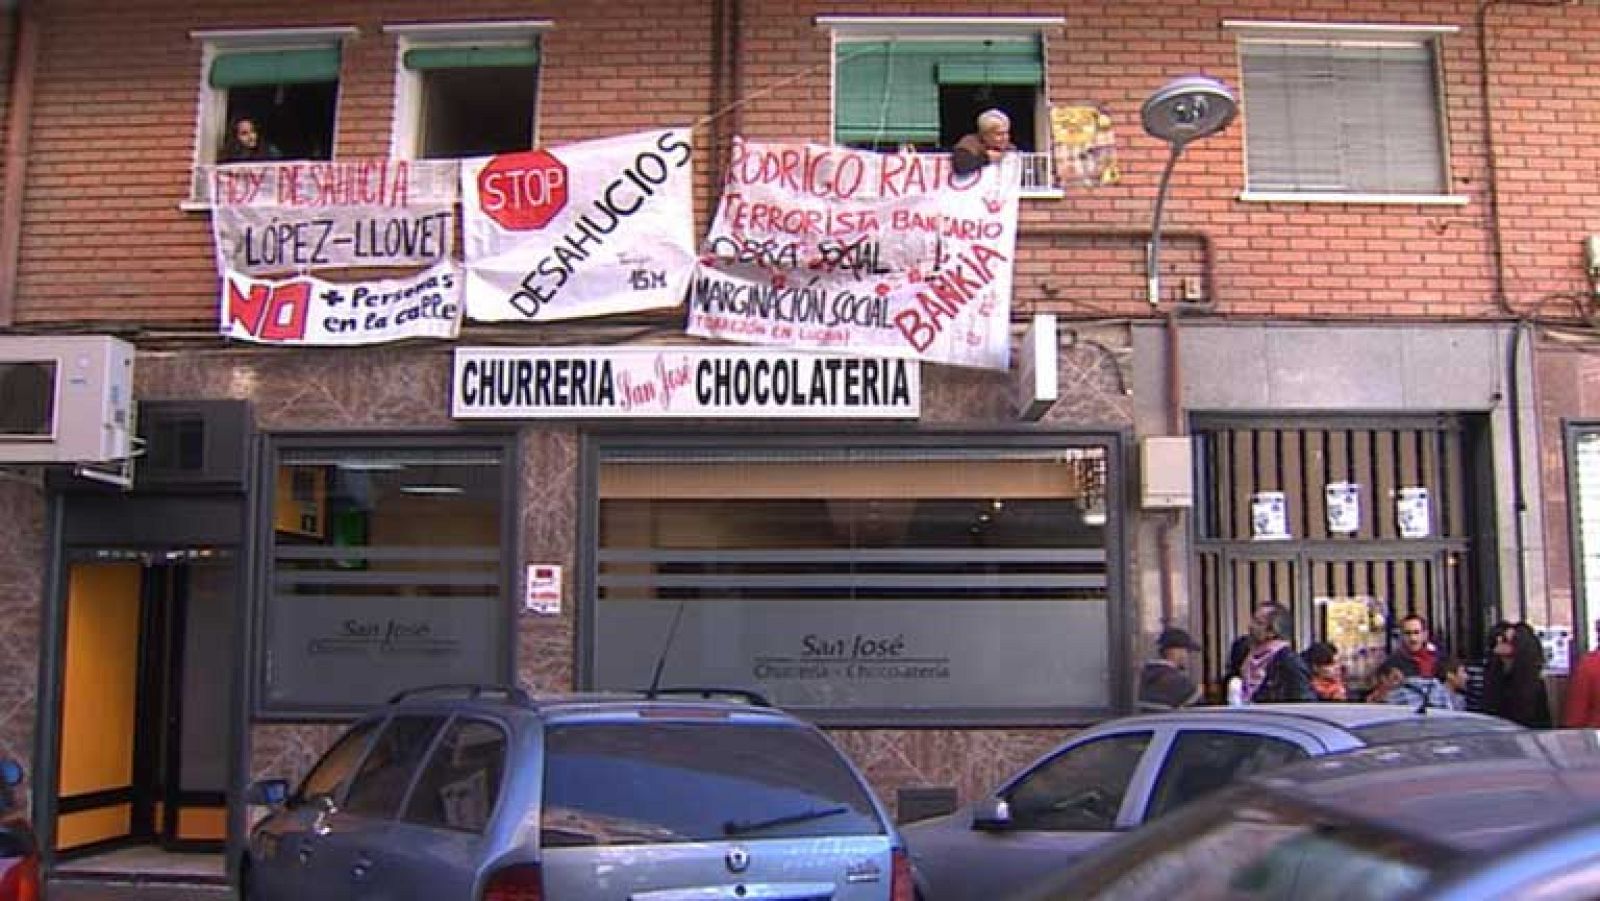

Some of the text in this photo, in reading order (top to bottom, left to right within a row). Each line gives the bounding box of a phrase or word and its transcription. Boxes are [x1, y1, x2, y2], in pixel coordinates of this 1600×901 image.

[484, 168, 564, 211] STOP
[726, 136, 864, 198] RODRIGO
[246, 213, 453, 266] LÓPEZ-LLOVET
[508, 131, 692, 318] DESAHUCIOS
[723, 193, 880, 236] TERRORISTA
[229, 278, 313, 341] NO
[364, 312, 389, 331] la
[394, 294, 458, 325] calle
[693, 274, 827, 325] MARGINACIÓN
[827, 289, 894, 328] SOCIAL
[894, 244, 1007, 353] BANKIA
[461, 359, 615, 406] CHURRERIA
[696, 358, 910, 406] CHOCOLATERIA
[803, 632, 905, 658] San José
